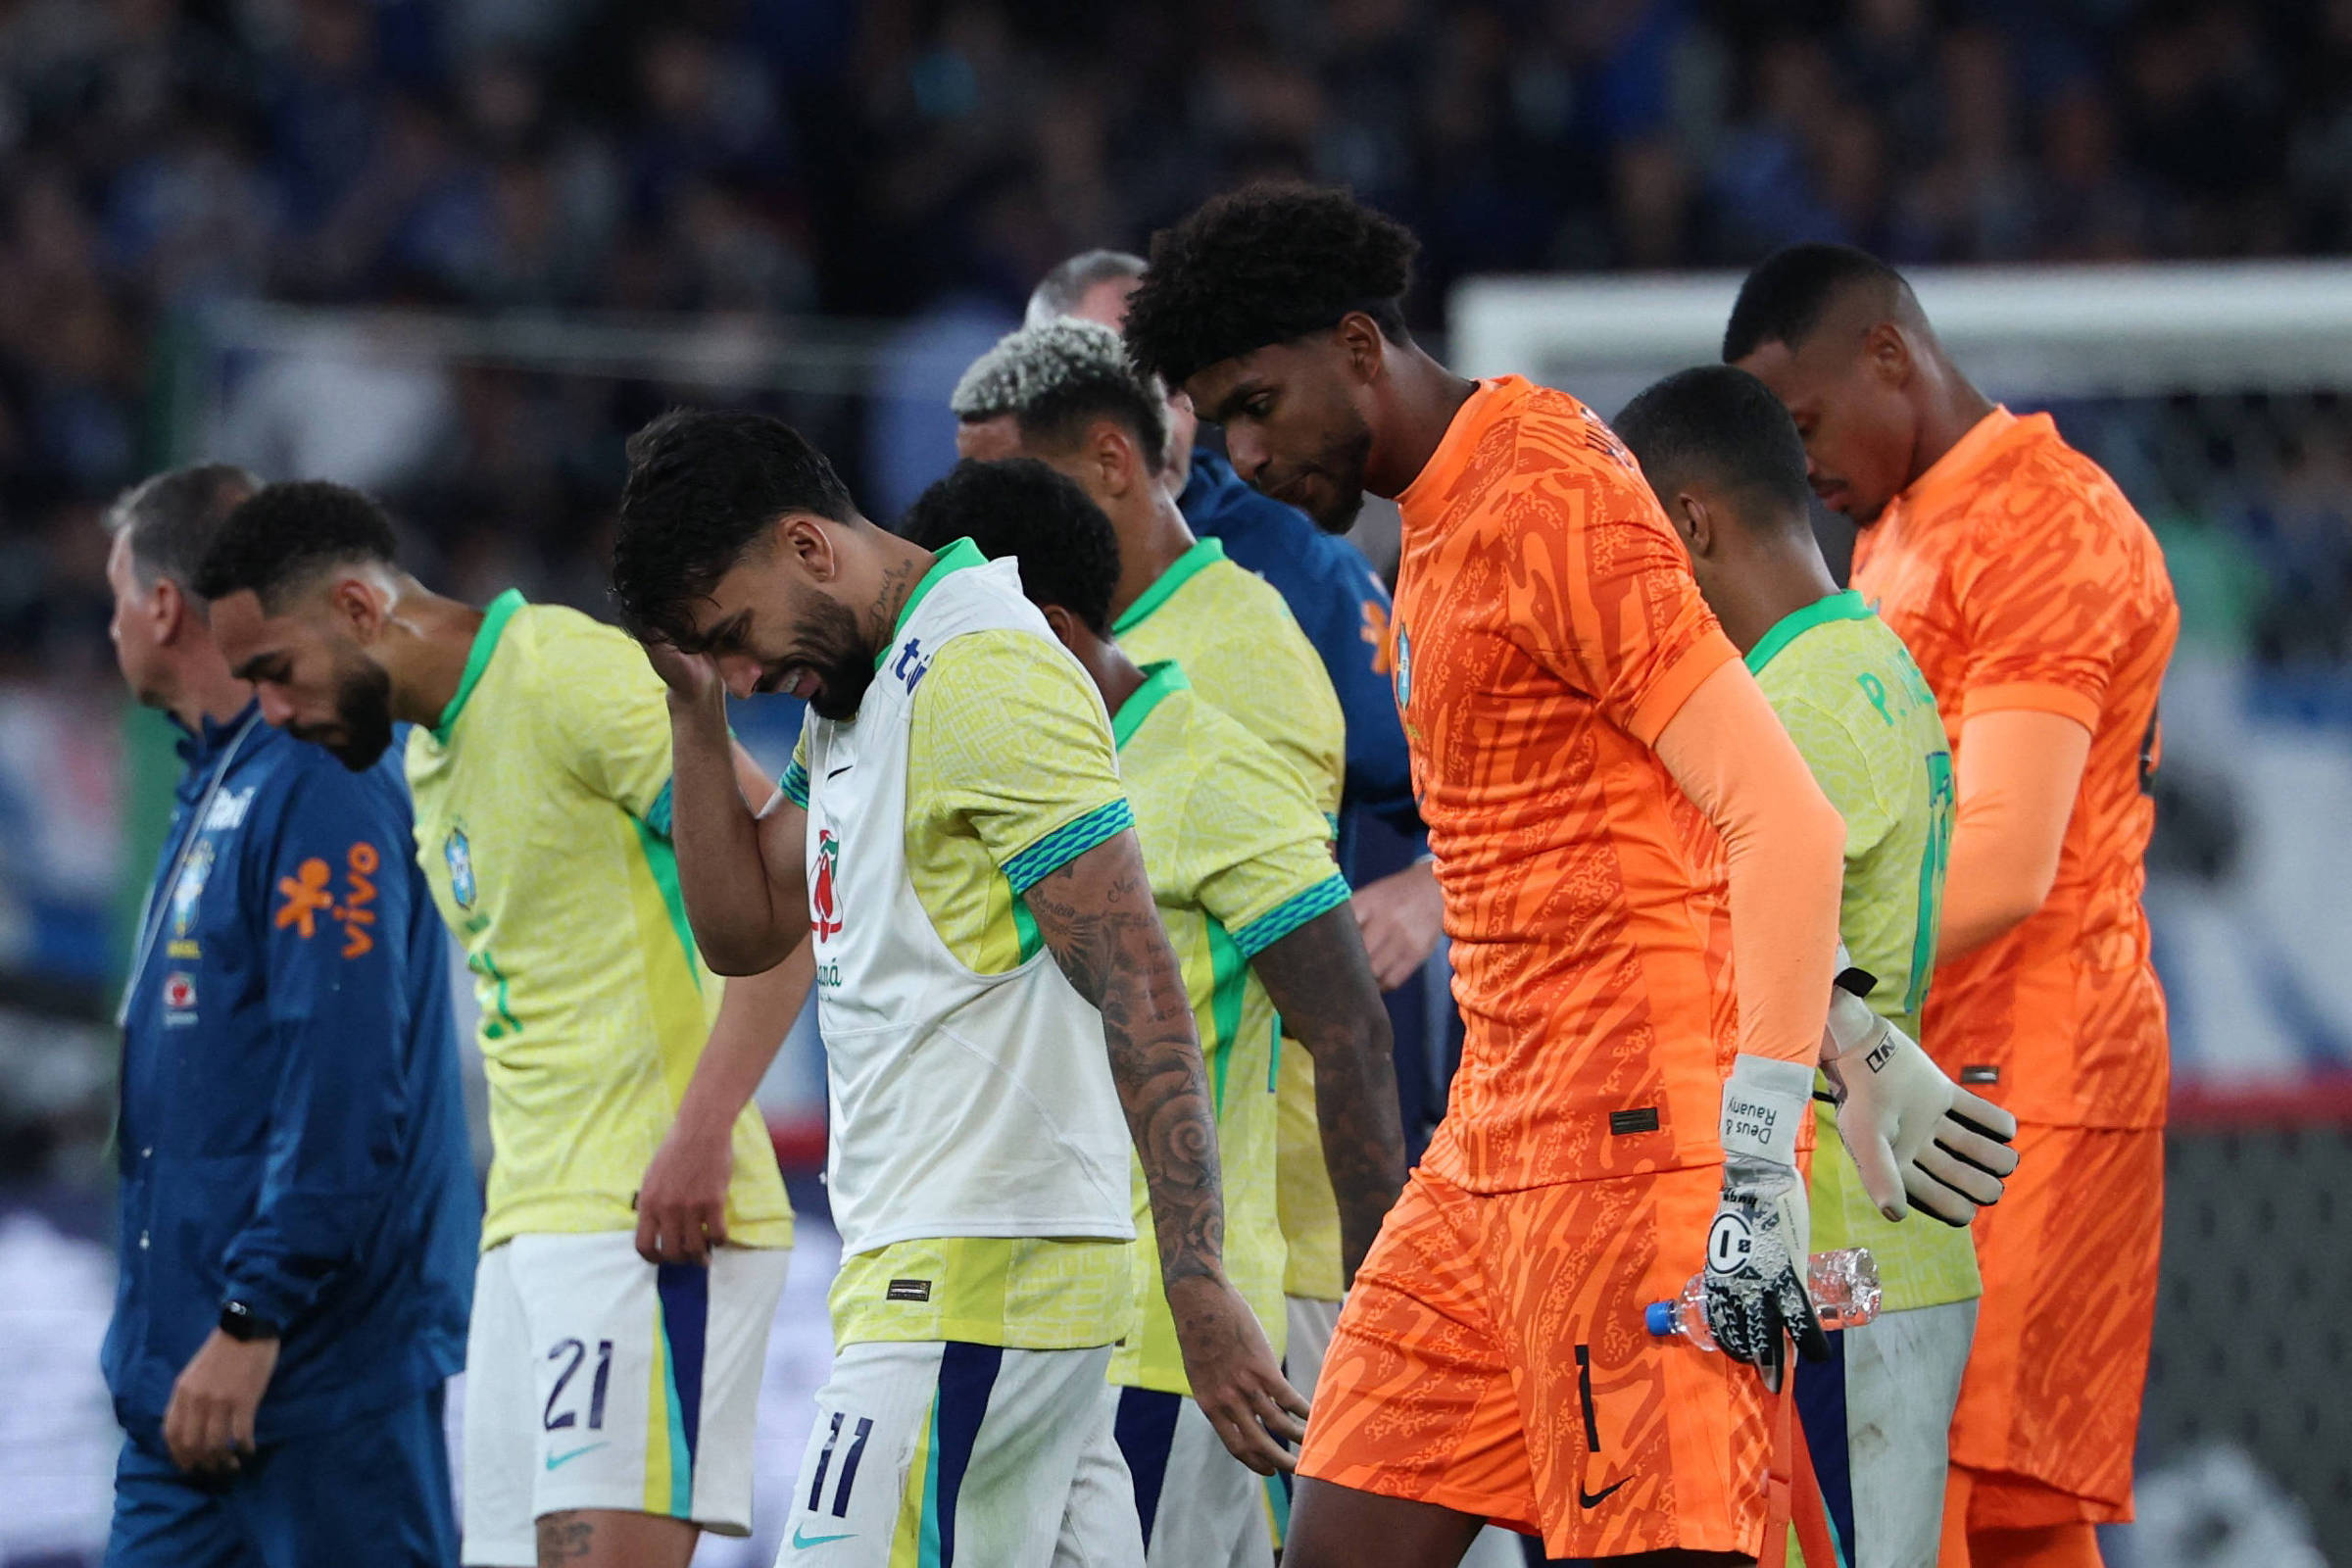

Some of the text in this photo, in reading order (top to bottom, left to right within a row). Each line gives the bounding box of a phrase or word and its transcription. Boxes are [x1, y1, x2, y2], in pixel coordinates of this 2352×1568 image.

[333, 841, 380, 959] vivo
[1726, 1118, 1773, 1146] Deus &
[1727, 1097, 1778, 1126] Rauany
[544, 1338, 614, 1432] 21
[1574, 1344, 1601, 1453] 1
[808, 1411, 875, 1519] 11
